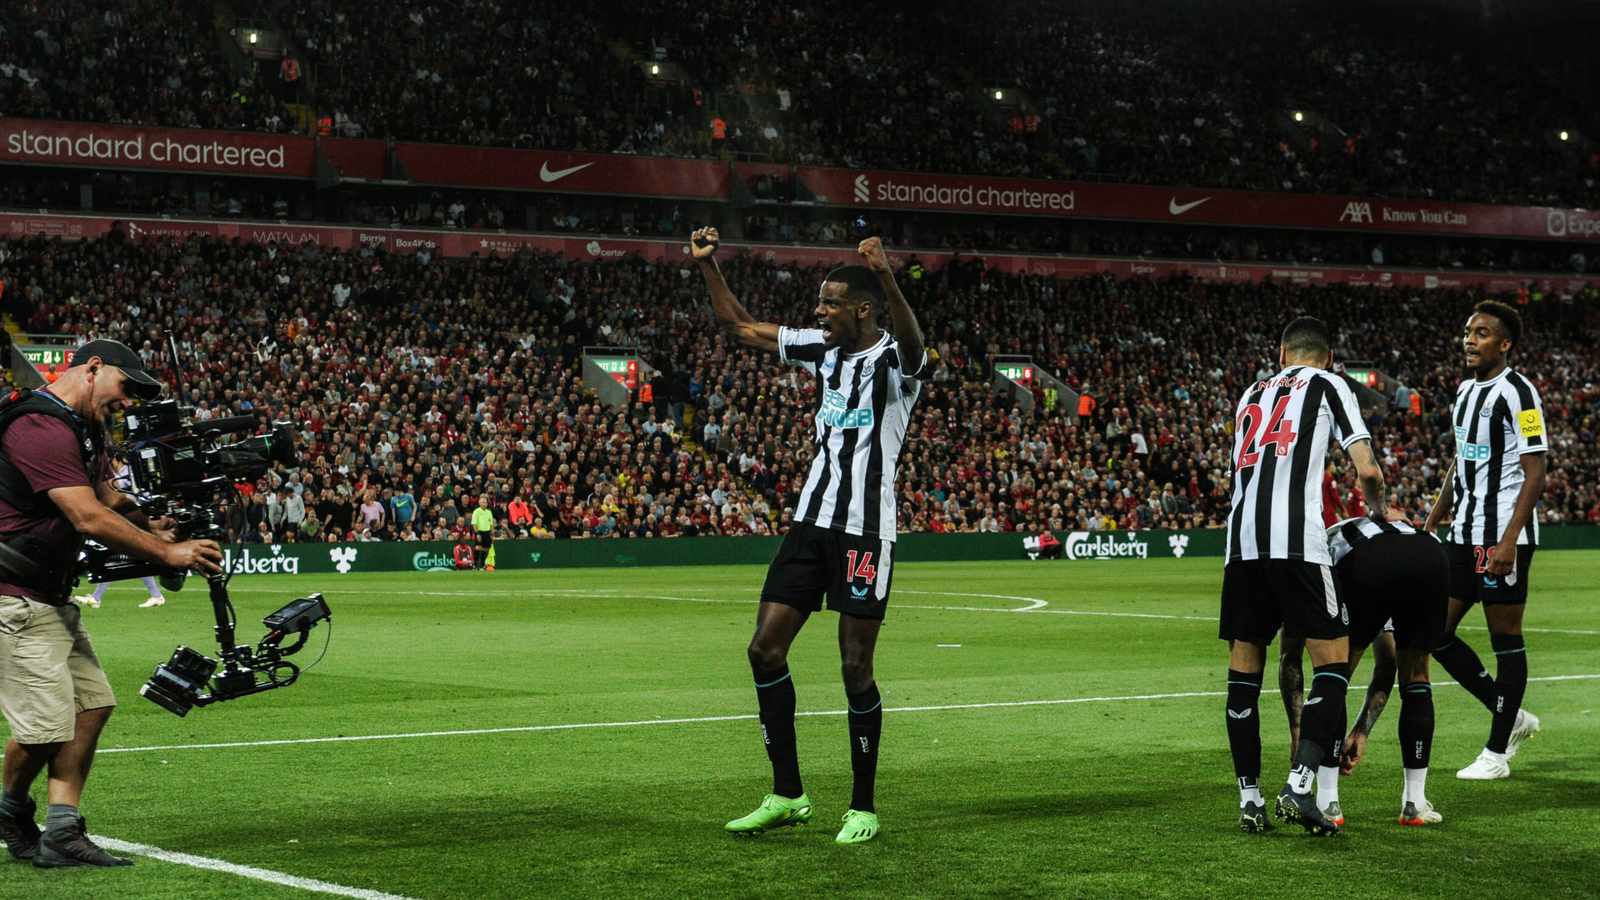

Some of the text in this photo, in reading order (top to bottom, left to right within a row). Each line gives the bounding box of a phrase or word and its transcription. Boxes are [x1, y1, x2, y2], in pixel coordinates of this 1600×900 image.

[8, 130, 284, 168] standard chartered
[877, 181, 1075, 210] standard chartered
[1339, 202, 1374, 224] AXA
[1383, 207, 1467, 225] Know You Can
[252, 231, 320, 244] MATALAN
[1236, 395, 1297, 472] 24
[1065, 531, 1149, 560] Carlsberg
[220, 549, 300, 575] lsberg
[413, 551, 456, 571] Carlsbe
[847, 550, 877, 585] 14
